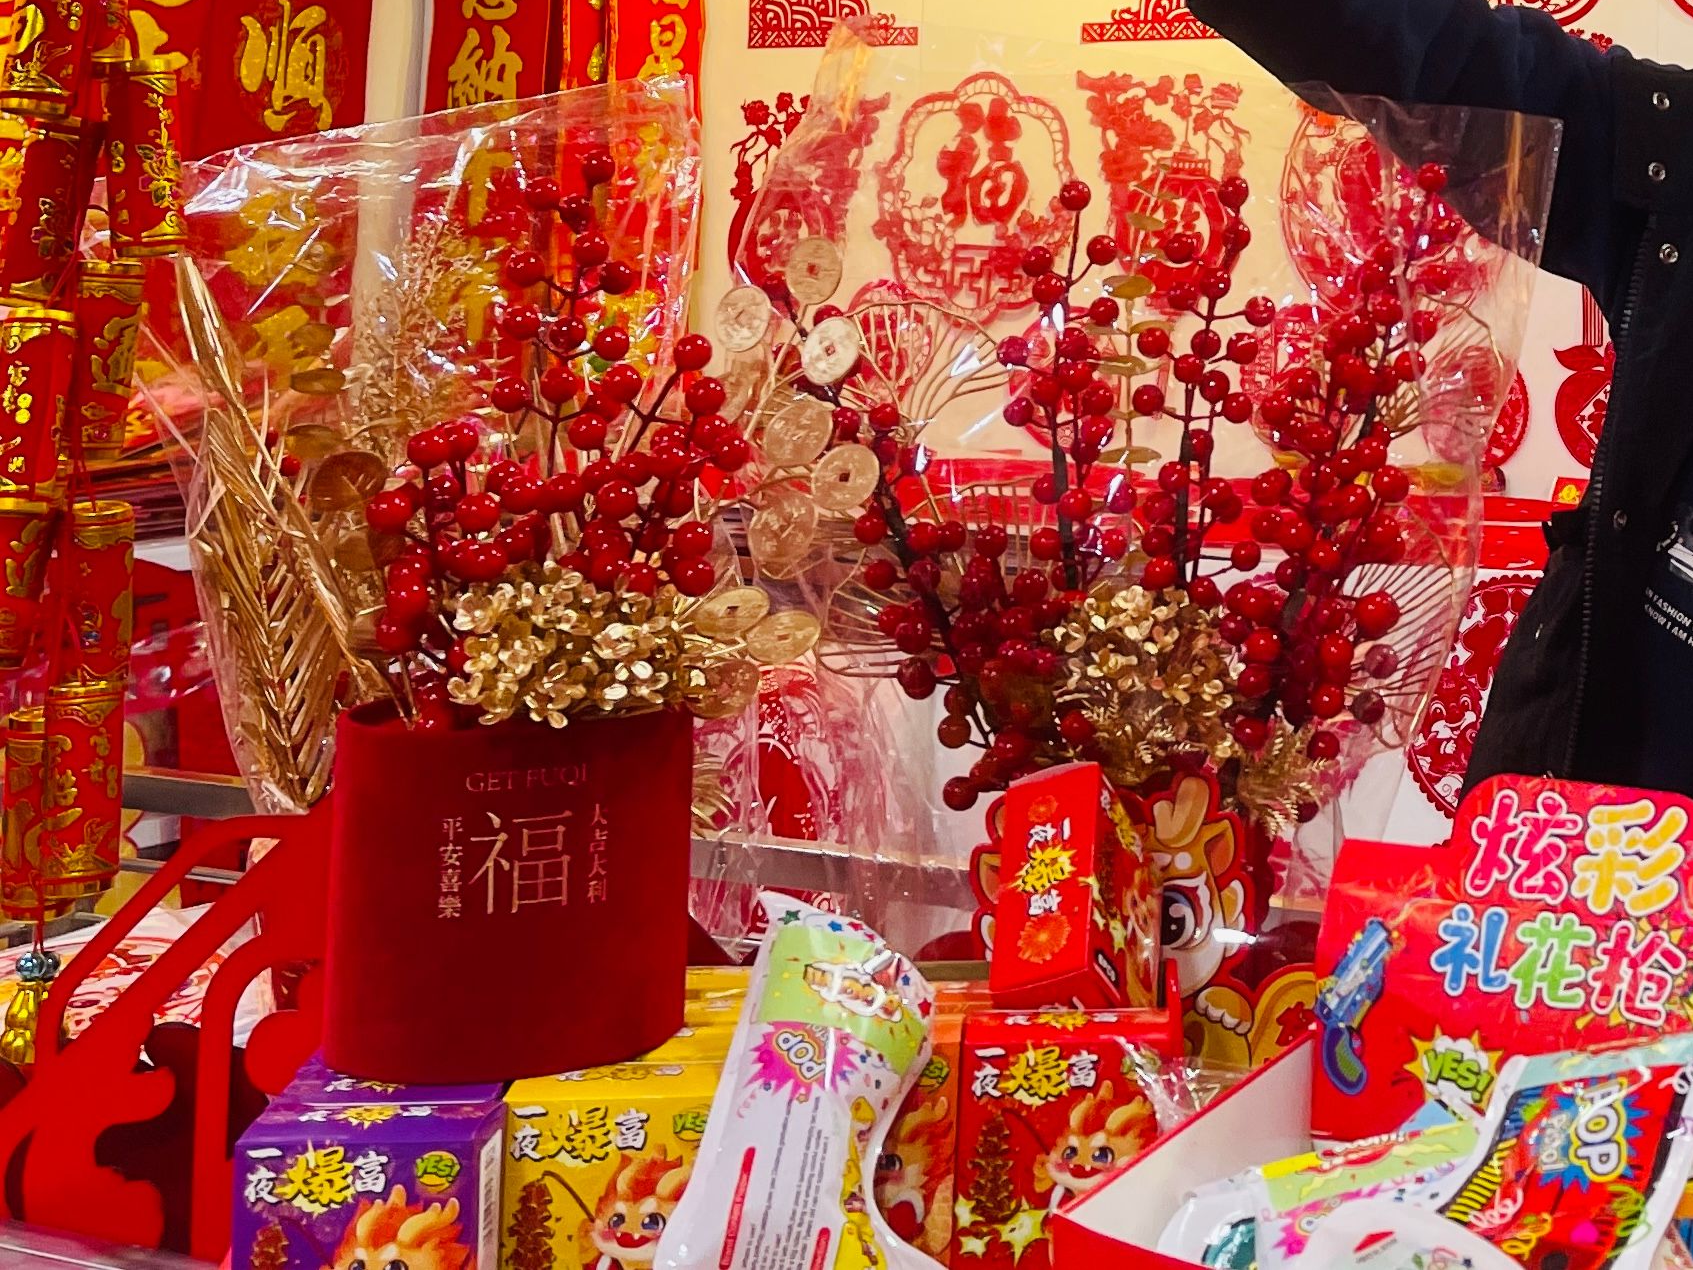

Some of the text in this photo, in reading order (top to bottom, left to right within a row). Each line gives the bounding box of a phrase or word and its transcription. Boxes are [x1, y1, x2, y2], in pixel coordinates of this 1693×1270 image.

[937, 97, 1030, 227] 福
[1652, 594, 1693, 628] FASHION
[1671, 625, 1687, 642] AM
[466, 771, 515, 793] GET
[467, 810, 573, 915] 福
[1464, 788, 1690, 917] 炫彩
[972, 1044, 1099, 1102] 一夜爆富
[1424, 1044, 1496, 1103] YES!
[509, 1104, 651, 1163] 一夜爆富
[244, 1145, 389, 1208] 一夜爆富
[414, 1153, 461, 1181] YES!
